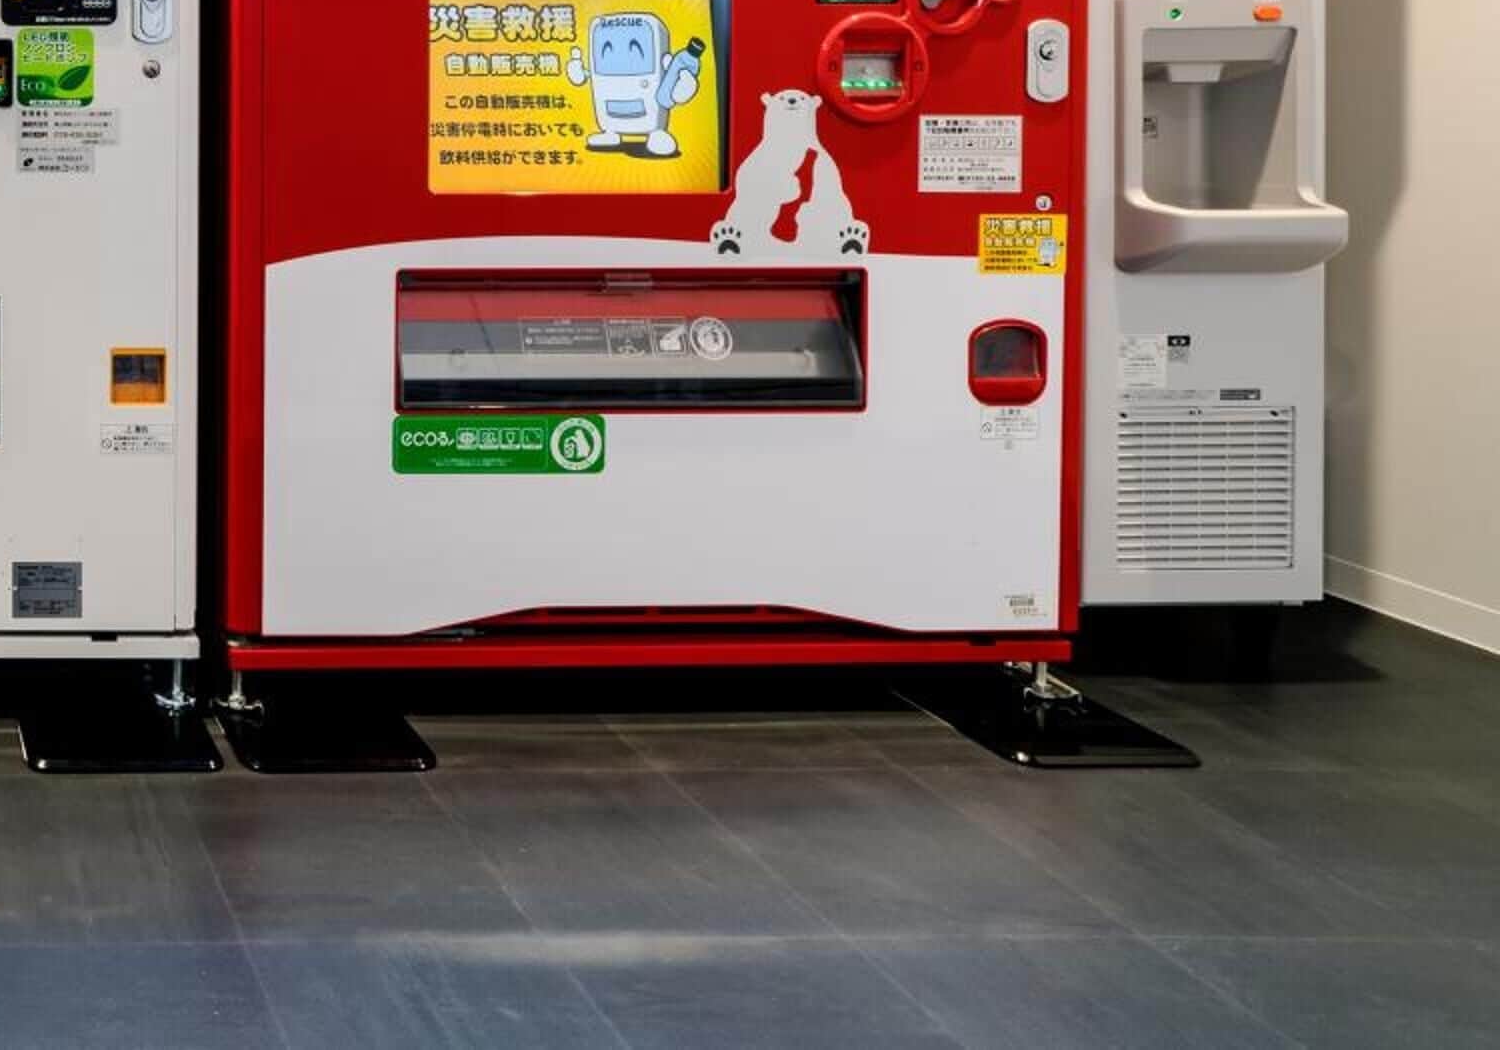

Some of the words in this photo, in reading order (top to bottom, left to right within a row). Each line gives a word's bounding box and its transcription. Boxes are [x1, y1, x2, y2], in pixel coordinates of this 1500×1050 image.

[429, 4, 577, 42] 災害救援
[445, 53, 561, 76] 自動販売機
[21, 79, 45, 92] Eco
